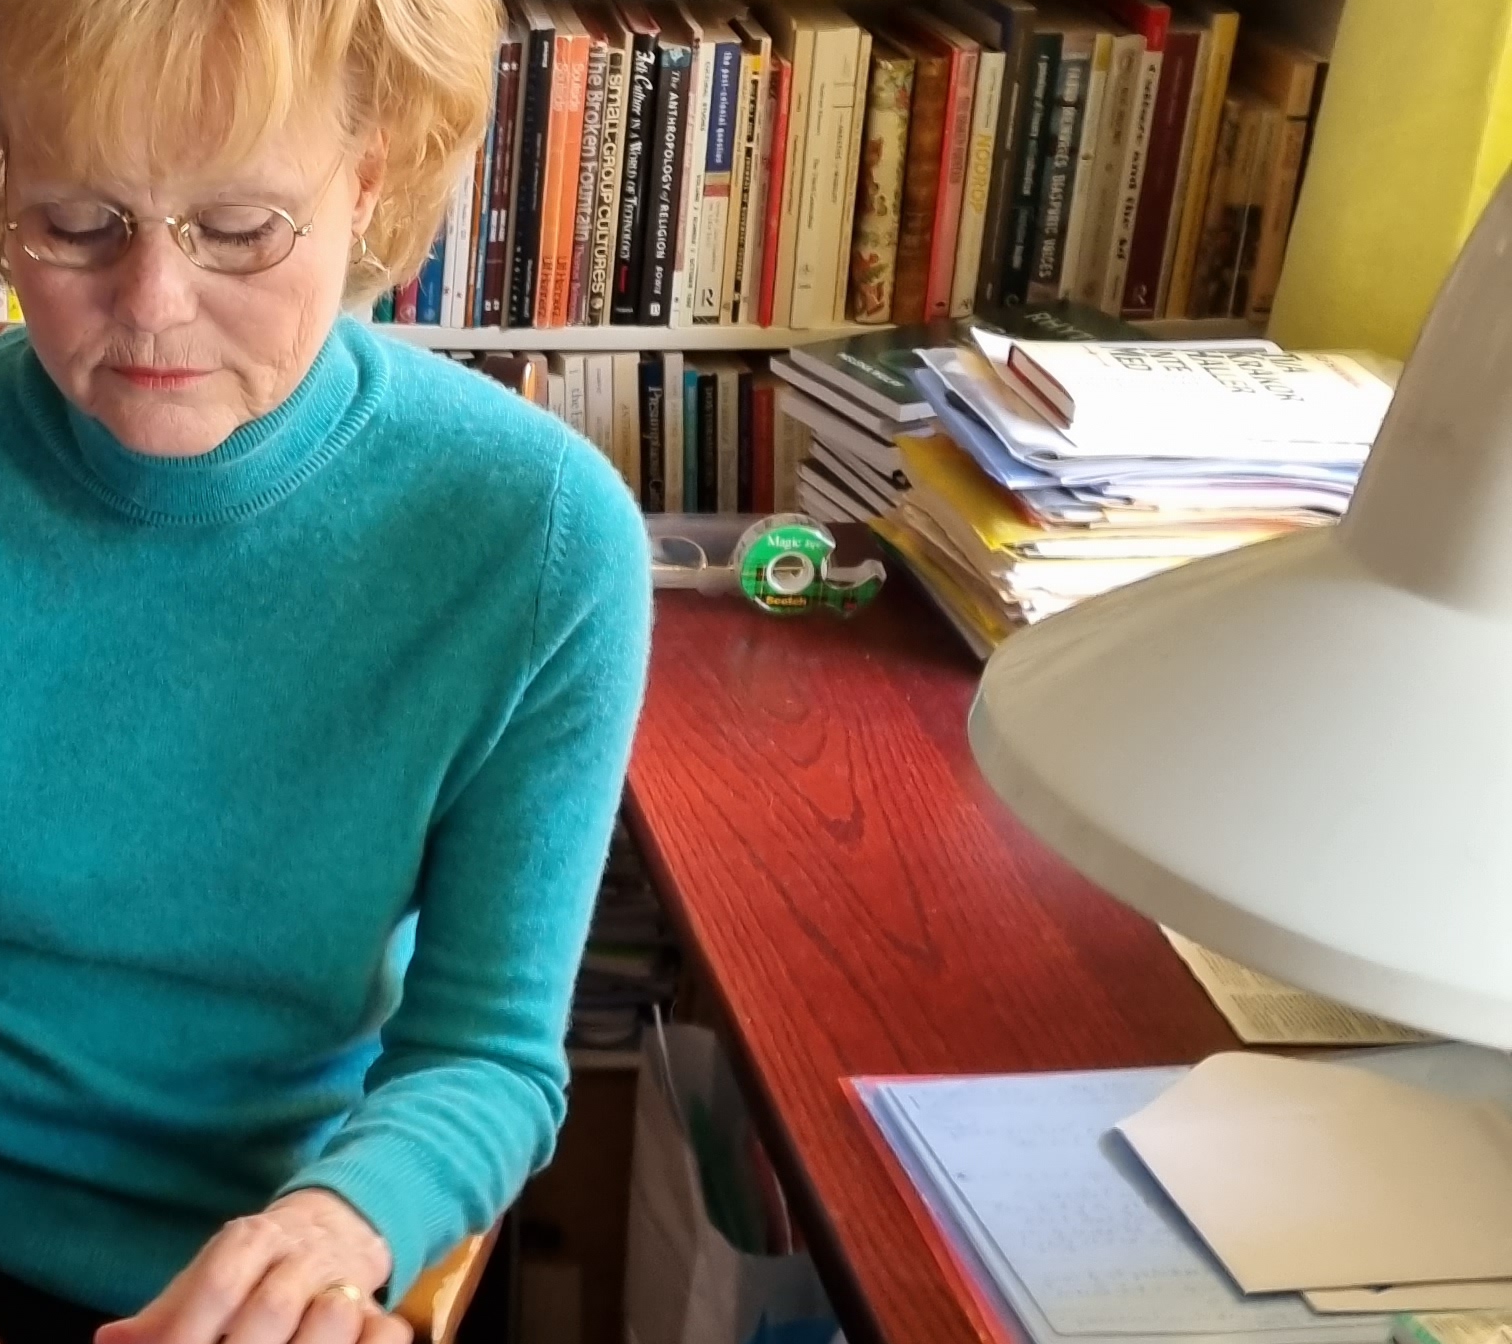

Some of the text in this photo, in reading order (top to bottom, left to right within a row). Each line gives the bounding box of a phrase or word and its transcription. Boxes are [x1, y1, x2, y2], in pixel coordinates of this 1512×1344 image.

[574, 90, 602, 241] Broken Fountain
[655, 71, 681, 258] The ANTHROPOLOGY of RELIGION
[768, 535, 800, 549] Magic
